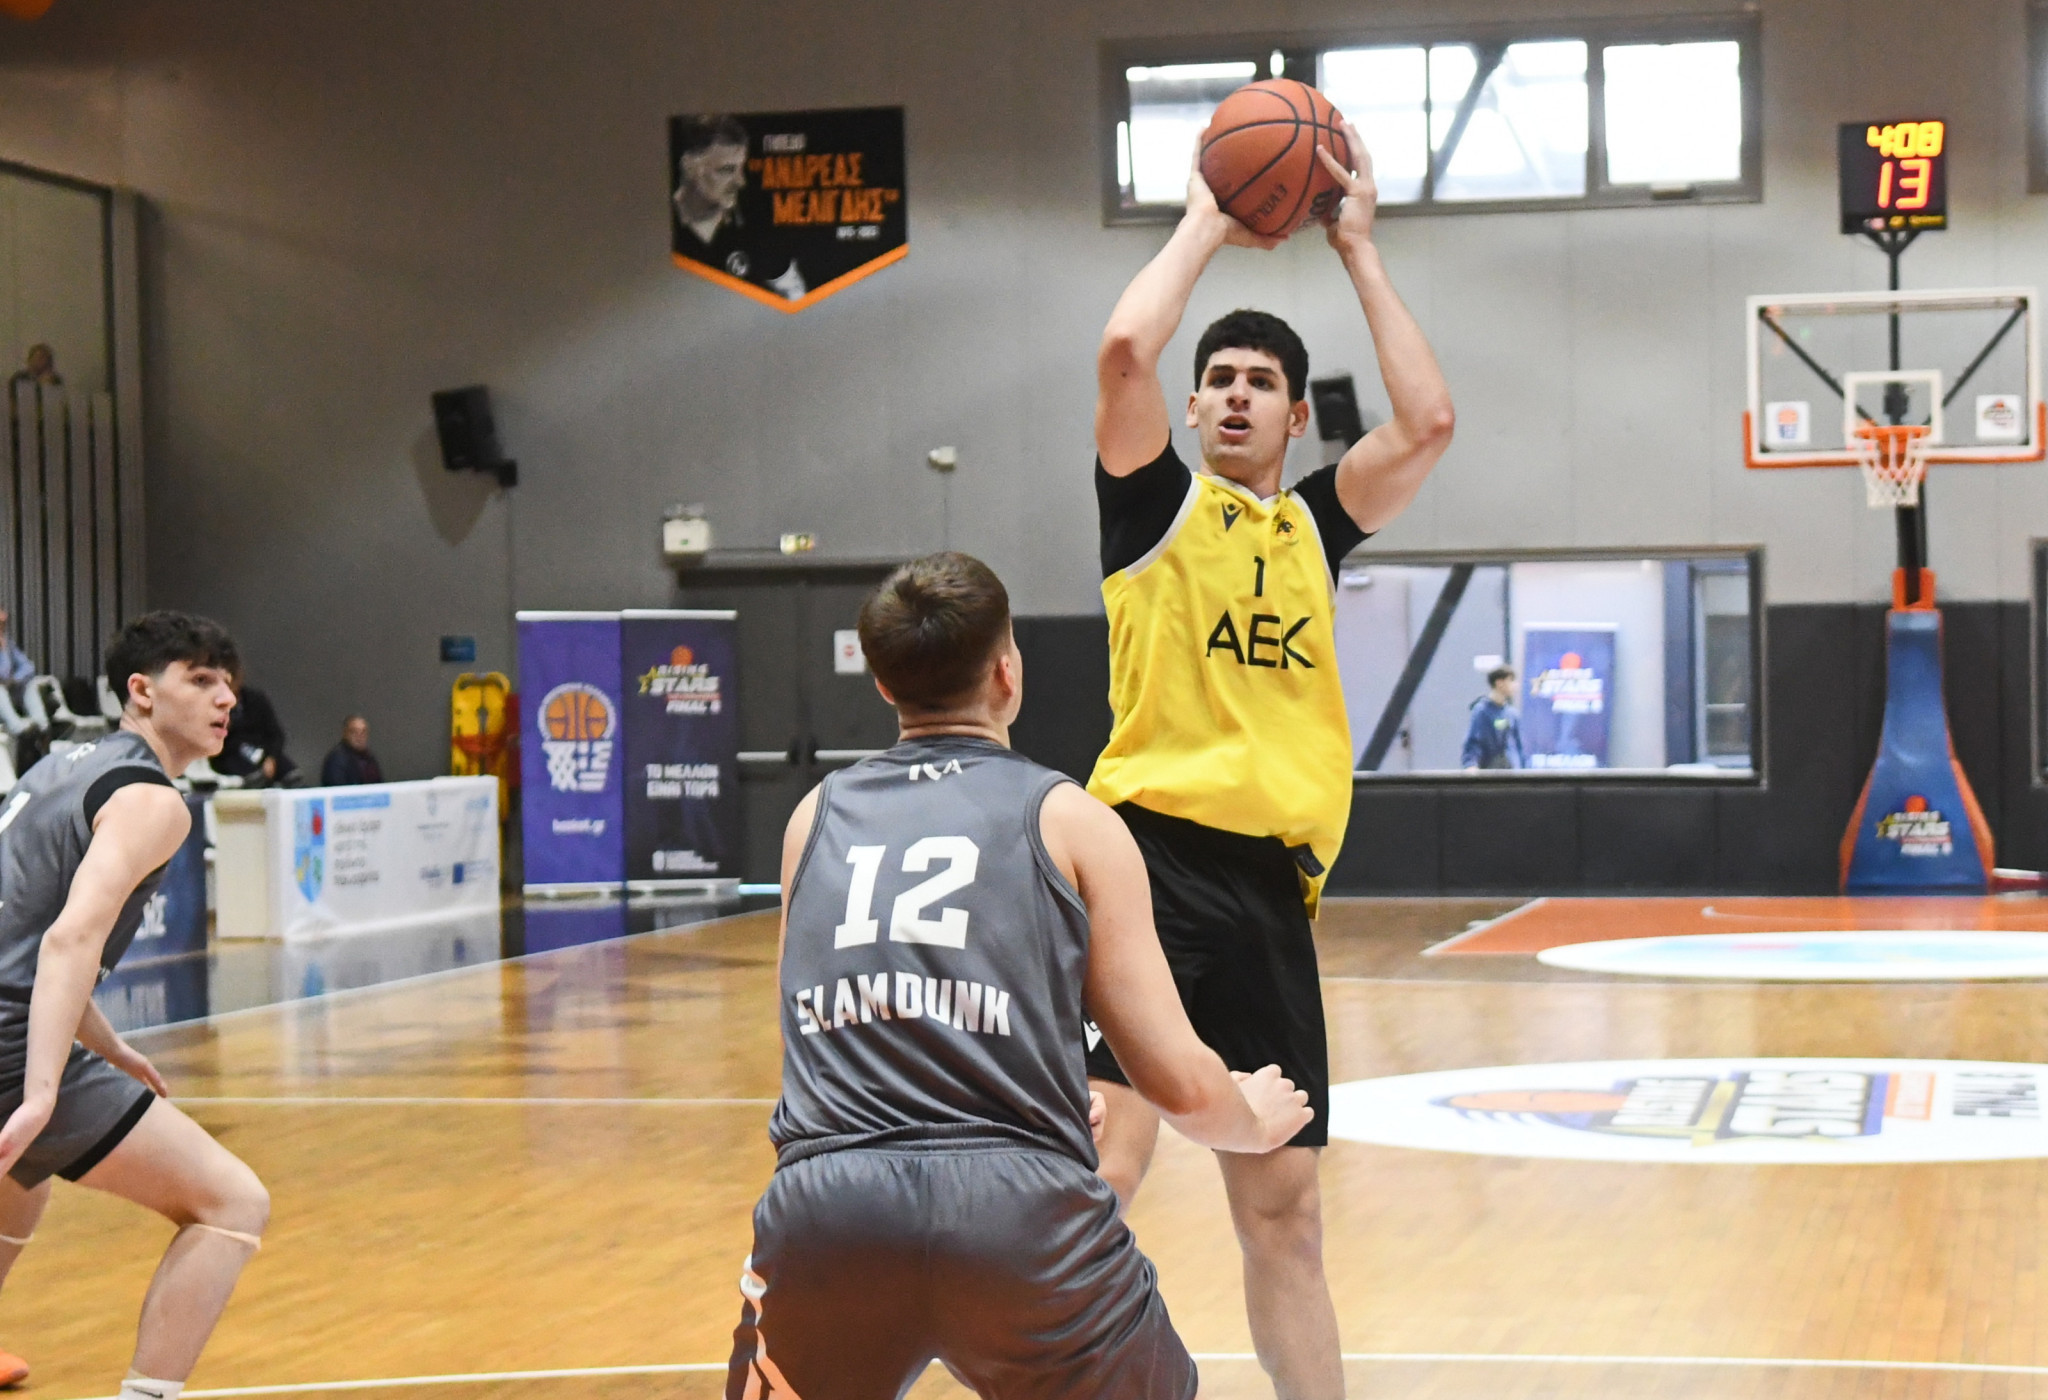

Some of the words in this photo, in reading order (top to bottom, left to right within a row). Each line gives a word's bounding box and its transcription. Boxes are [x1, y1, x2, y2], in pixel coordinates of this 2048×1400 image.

[1877, 158, 1932, 210] 13
[1253, 555, 1265, 597] 1
[649, 676, 720, 696] STARS
[834, 835, 980, 950] 12
